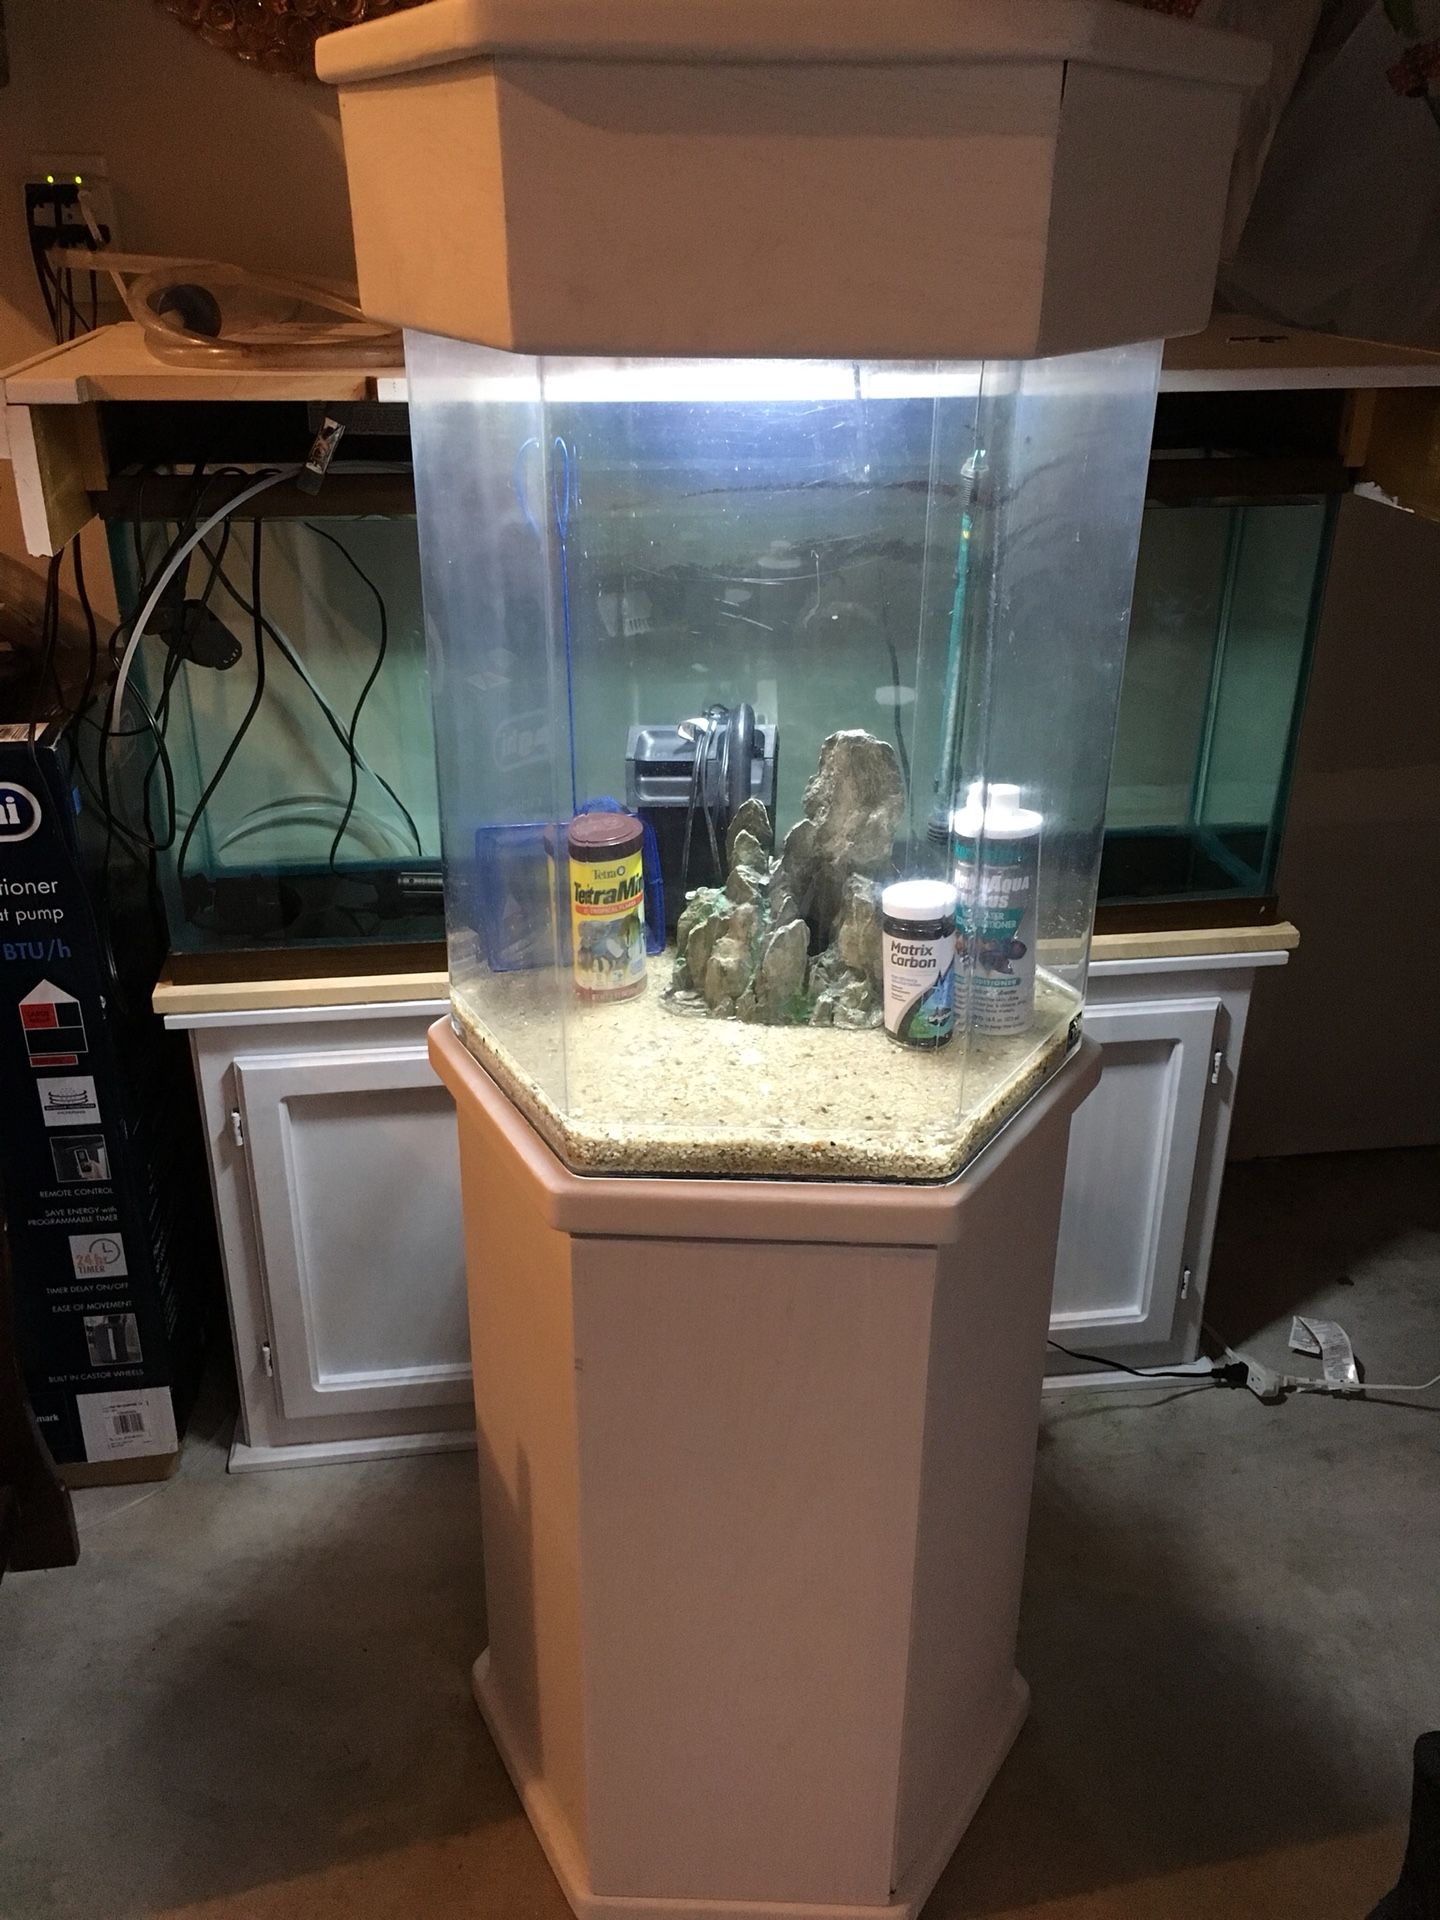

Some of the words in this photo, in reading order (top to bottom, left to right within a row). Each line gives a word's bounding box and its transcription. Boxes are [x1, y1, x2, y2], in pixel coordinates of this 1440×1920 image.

[592, 869, 617, 880] Tetra
[15, 908, 64, 926] pump
[3, 938, 72, 961] BTU/h
[890, 940, 934, 957] Matrix
[890, 952, 937, 969] Carbon
[40, 1188, 72, 1198] REMOTE
[74, 1186, 113, 1196] CONTROL
[45, 1208, 65, 1217] SAVE
[67, 1206, 99, 1216] ENERGY
[27, 1215, 93, 1226] PROGRAMMABLE
[96, 1213, 118, 1222] TIMER
[77, 1265, 106, 1275] TIMER
[46, 1286, 69, 1295] TIMER
[70, 1284, 94, 1294] DELAY
[96, 1281, 128, 1291] ON/OFF
[52, 1304, 71, 1313] EASE
[73, 1303, 84, 1311] OF
[86, 1300, 132, 1310] MOVEMENT
[48, 1374, 68, 1383] BUILT
[70, 1373, 79, 1381] IN
[81, 1371, 112, 1381] CASTOR
[113, 1368, 145, 1378] WHEELS
